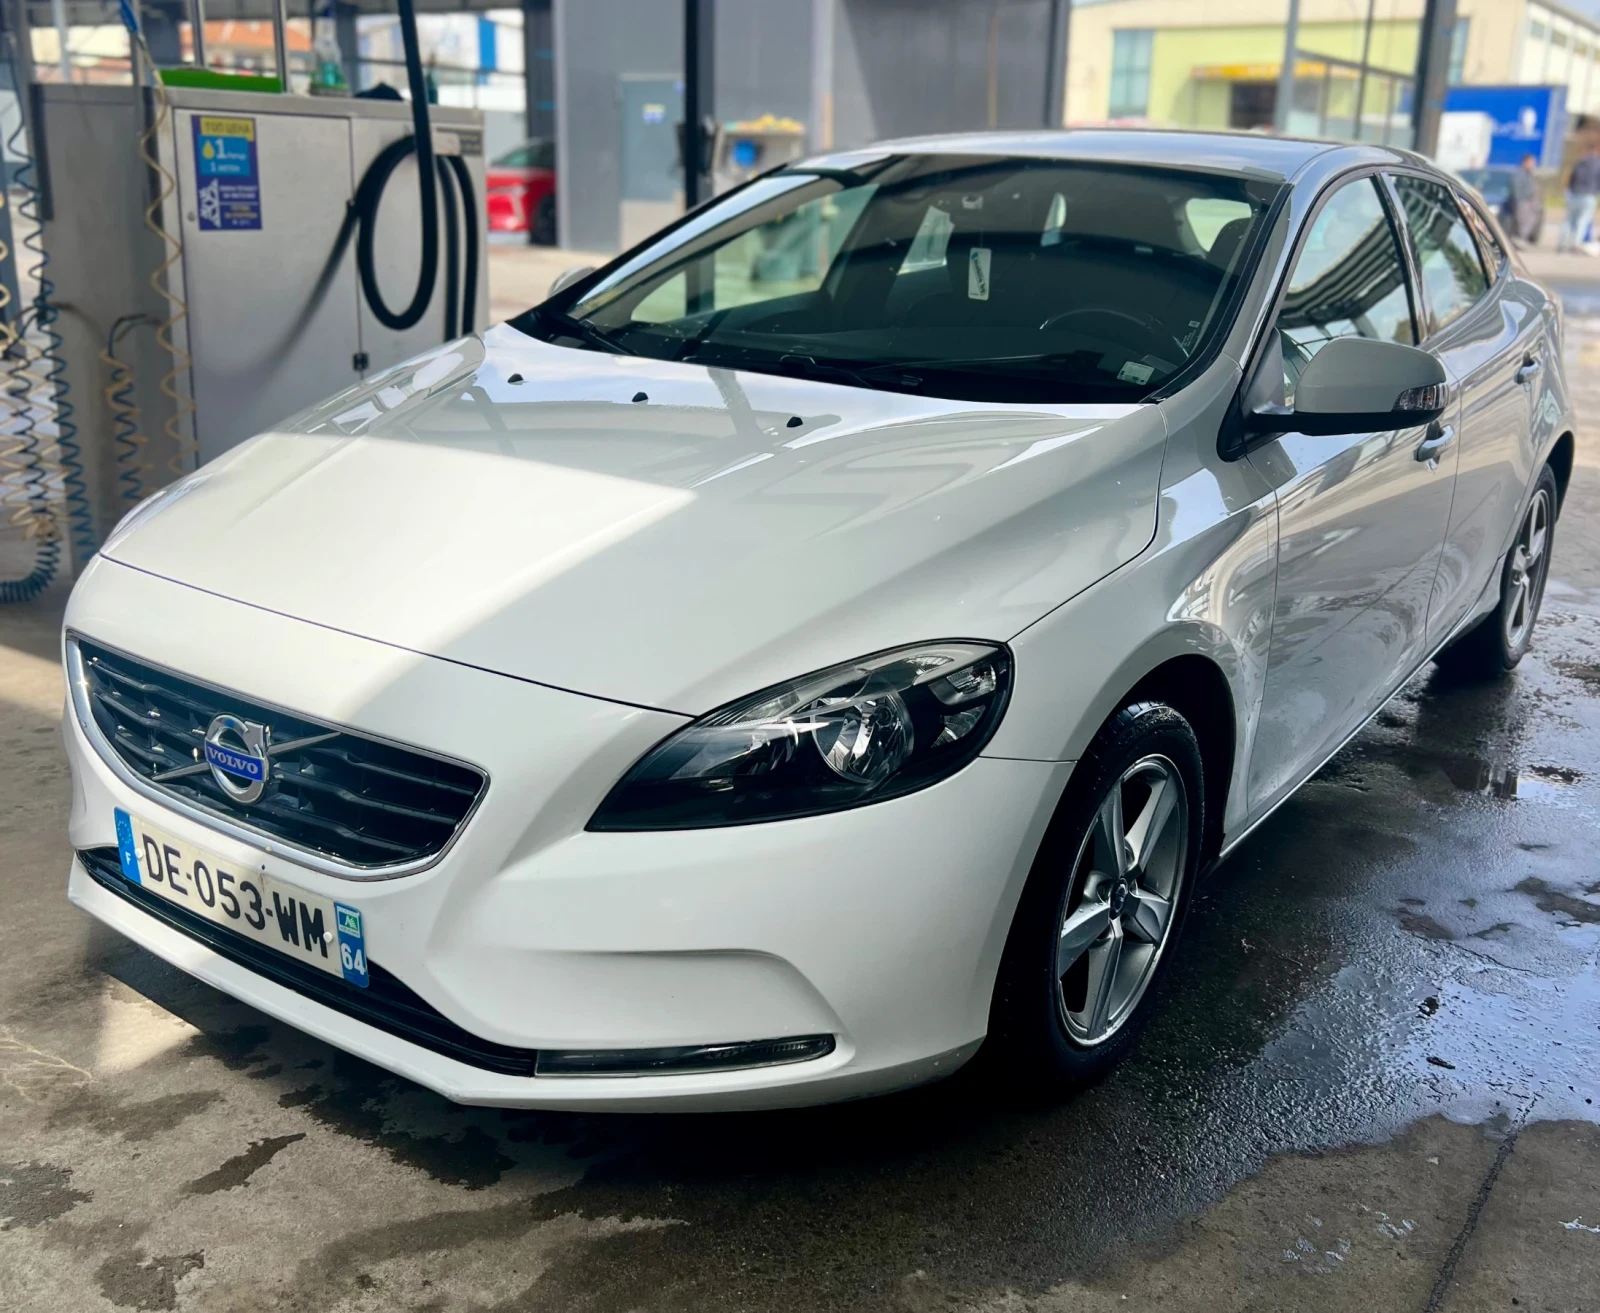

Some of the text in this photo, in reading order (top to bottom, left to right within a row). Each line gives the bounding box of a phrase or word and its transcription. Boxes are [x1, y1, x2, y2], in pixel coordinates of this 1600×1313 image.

[215, 138, 226, 159] 1
[207, 746, 258, 774] VOLVO
[125, 851, 131, 865] F
[142, 833, 328, 959] DE-053-WM
[341, 942, 366, 976] 64
